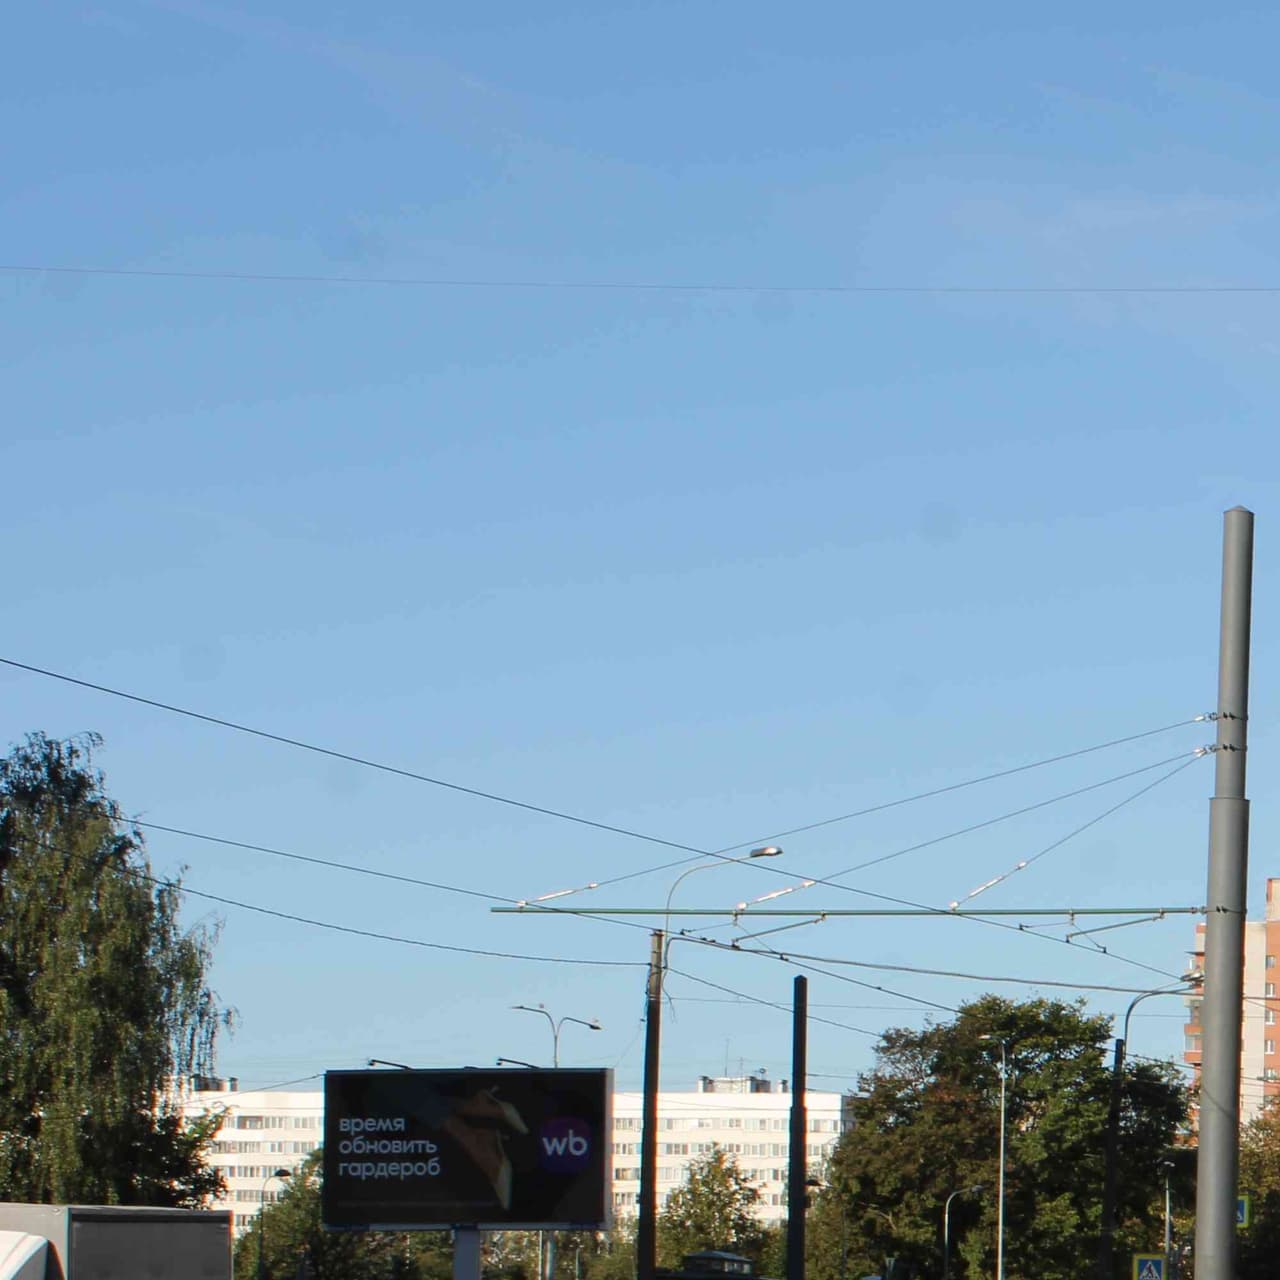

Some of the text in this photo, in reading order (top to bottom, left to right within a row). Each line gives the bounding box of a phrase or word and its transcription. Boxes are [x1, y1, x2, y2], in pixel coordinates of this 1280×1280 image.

[339, 1118, 405, 1136] время
[339, 1136, 438, 1154] обновить
[542, 1129, 588, 1156] wb
[339, 1157, 441, 1180] гардероб
